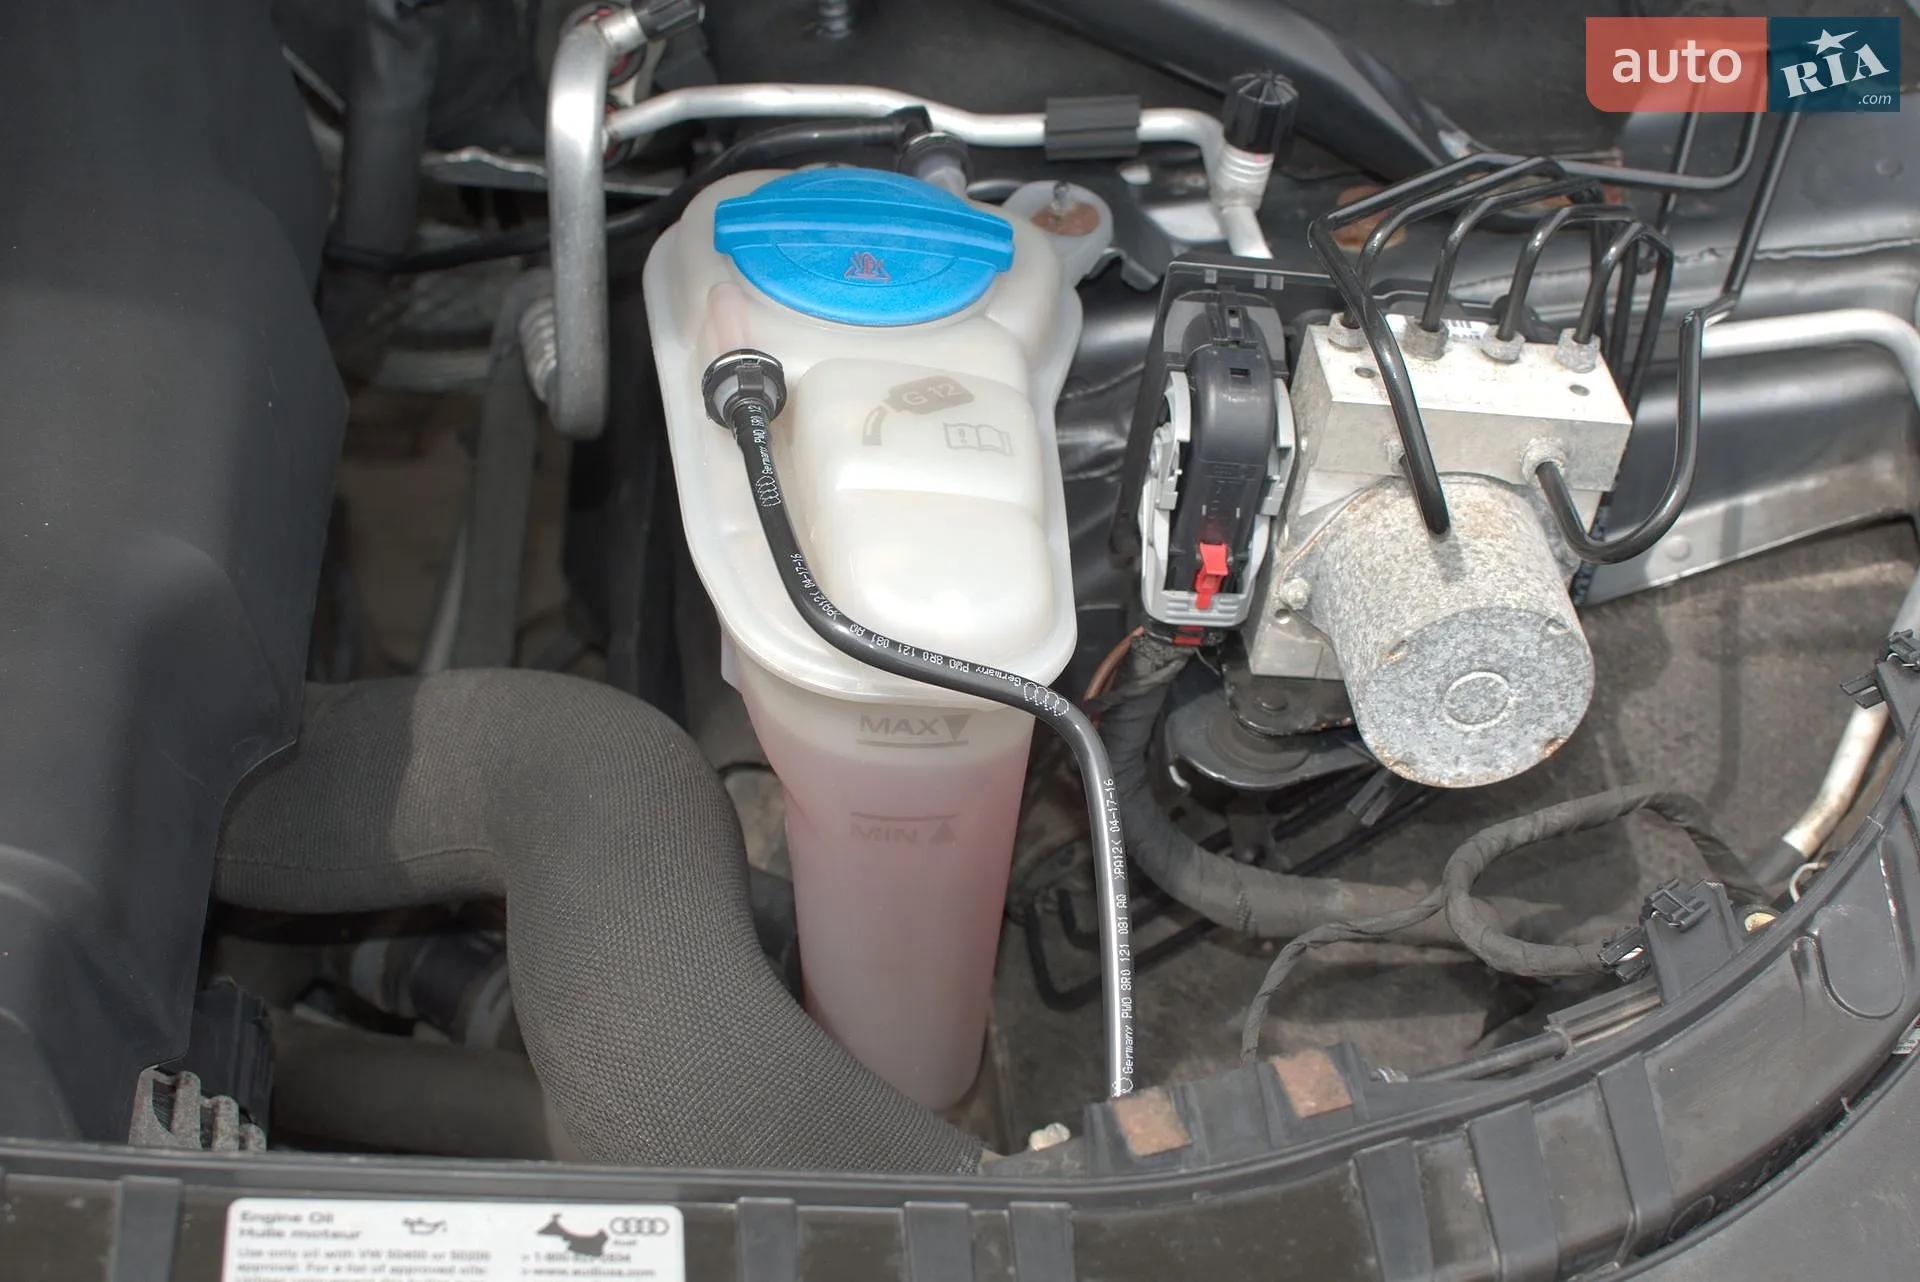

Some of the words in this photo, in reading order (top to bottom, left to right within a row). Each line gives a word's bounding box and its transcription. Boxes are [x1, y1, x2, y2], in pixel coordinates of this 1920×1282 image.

[790, 553, 816, 589] 04-17-16
[897, 642, 915, 658] 121
[975, 664, 1022, 687] Germany
[859, 713, 939, 735] MAX
[1104, 778, 1120, 833] 04-17-16
[850, 823, 918, 844] MIN
[1119, 943, 1130, 961] 121
[1122, 1024, 1133, 1074] Germany
[240, 1211, 303, 1224] Engine
[309, 1211, 334, 1224] Oil
[239, 1228, 285, 1239] Huile
[290, 1229, 361, 1240] moteur
